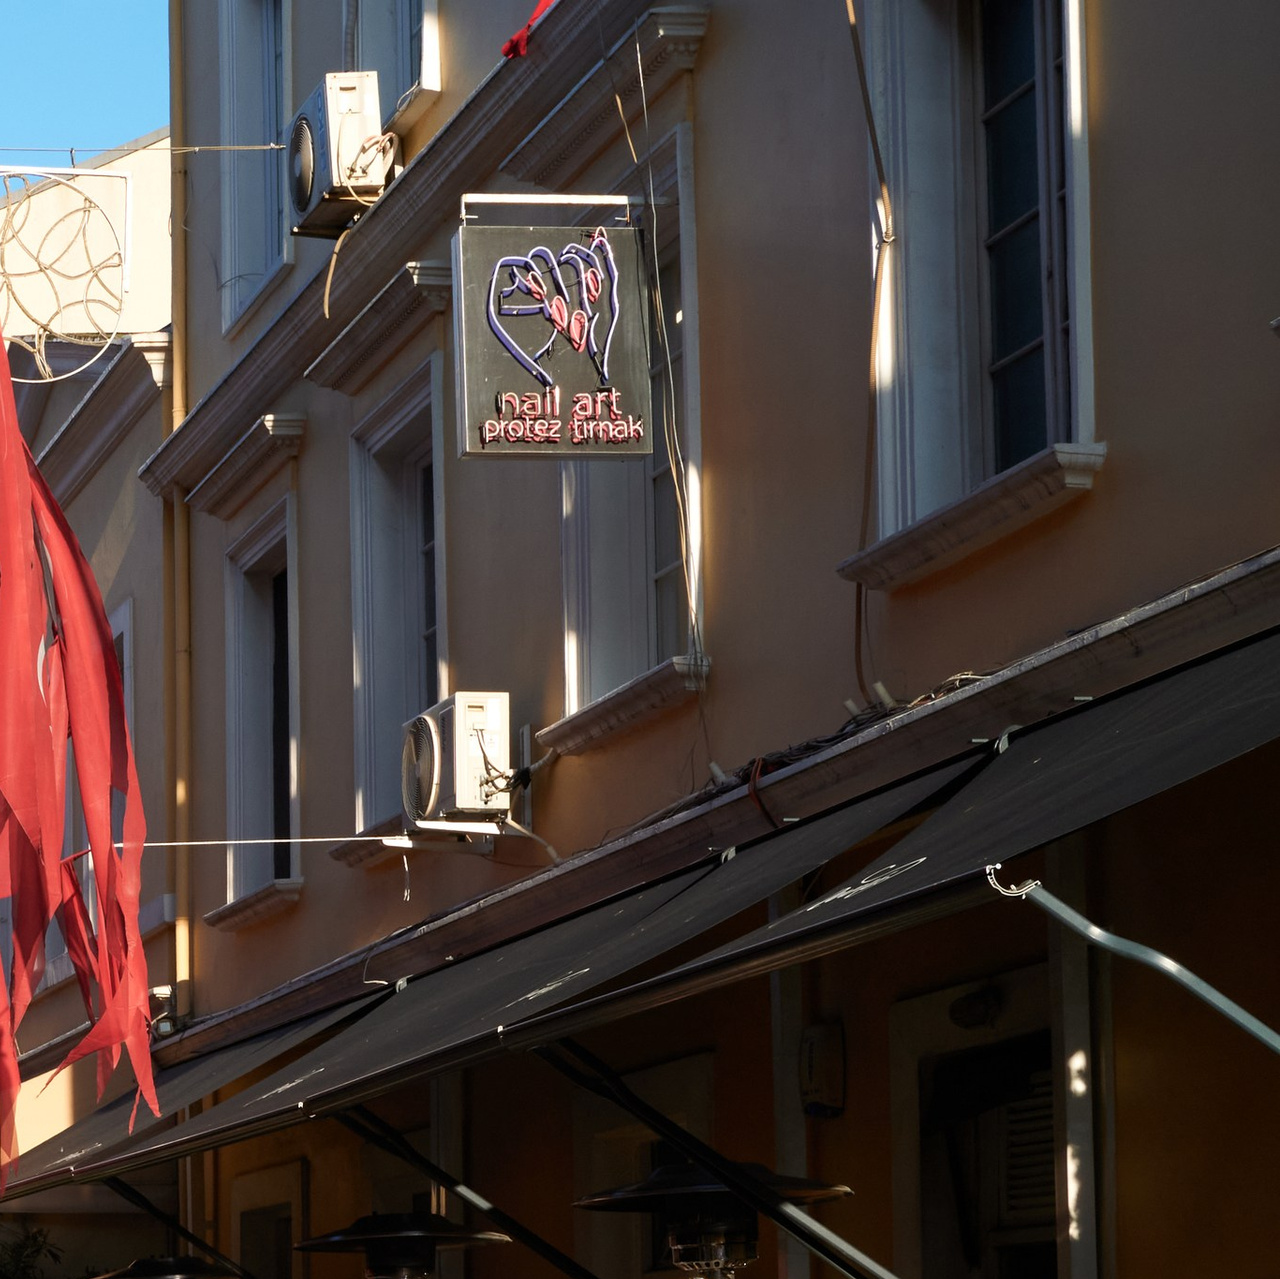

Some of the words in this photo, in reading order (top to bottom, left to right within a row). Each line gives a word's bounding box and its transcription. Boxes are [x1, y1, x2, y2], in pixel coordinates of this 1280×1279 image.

[501, 385, 561, 416] nail
[574, 387, 623, 416] art
[484, 415, 562, 444] protez
